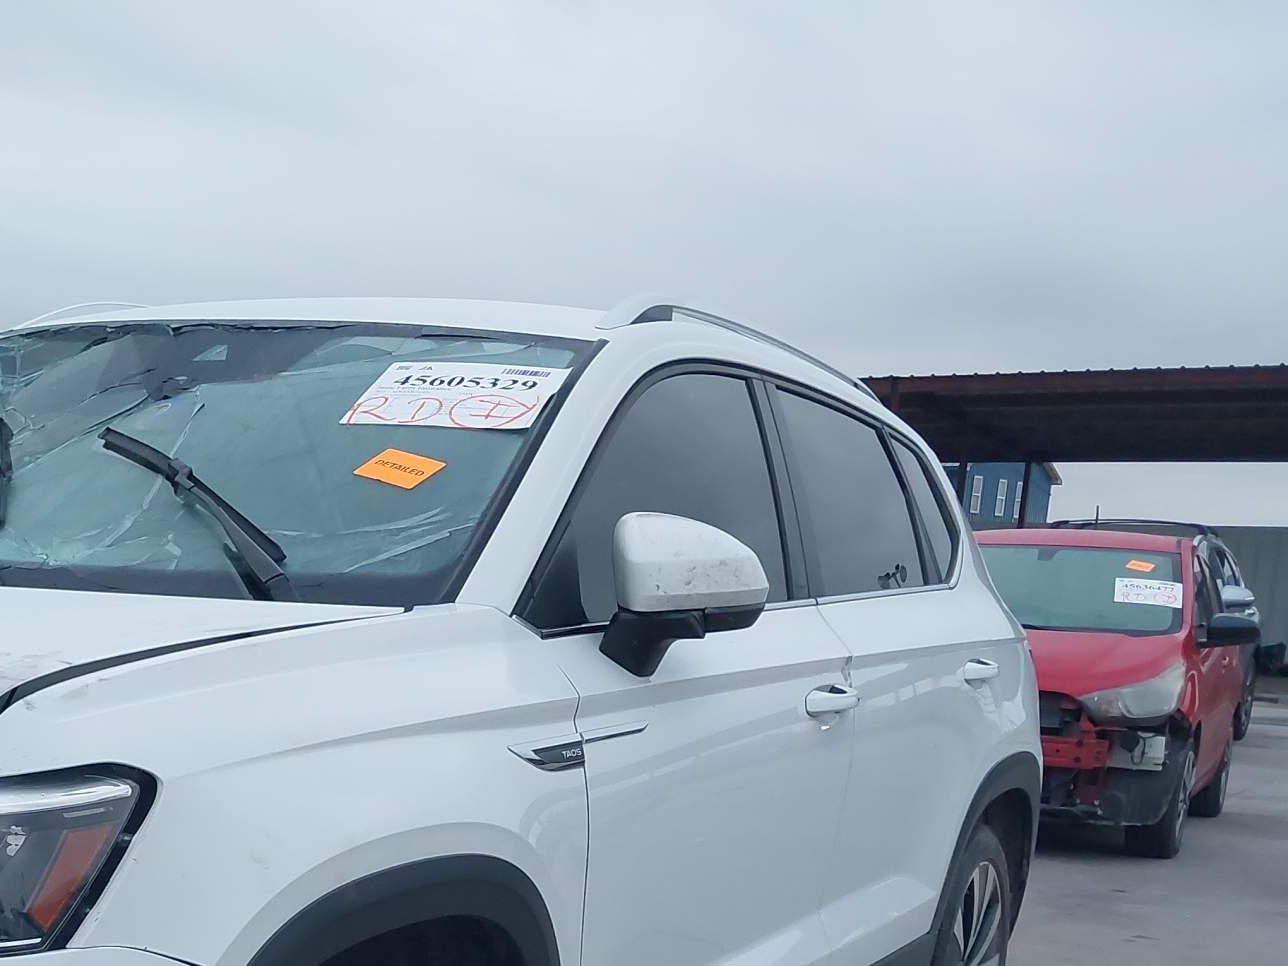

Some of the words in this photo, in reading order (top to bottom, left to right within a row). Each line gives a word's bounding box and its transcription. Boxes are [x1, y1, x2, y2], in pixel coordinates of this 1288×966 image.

[393, 374, 538, 391] 45605329
[374, 459, 425, 477] DETAILED
[562, 749, 582, 759] TAOS
